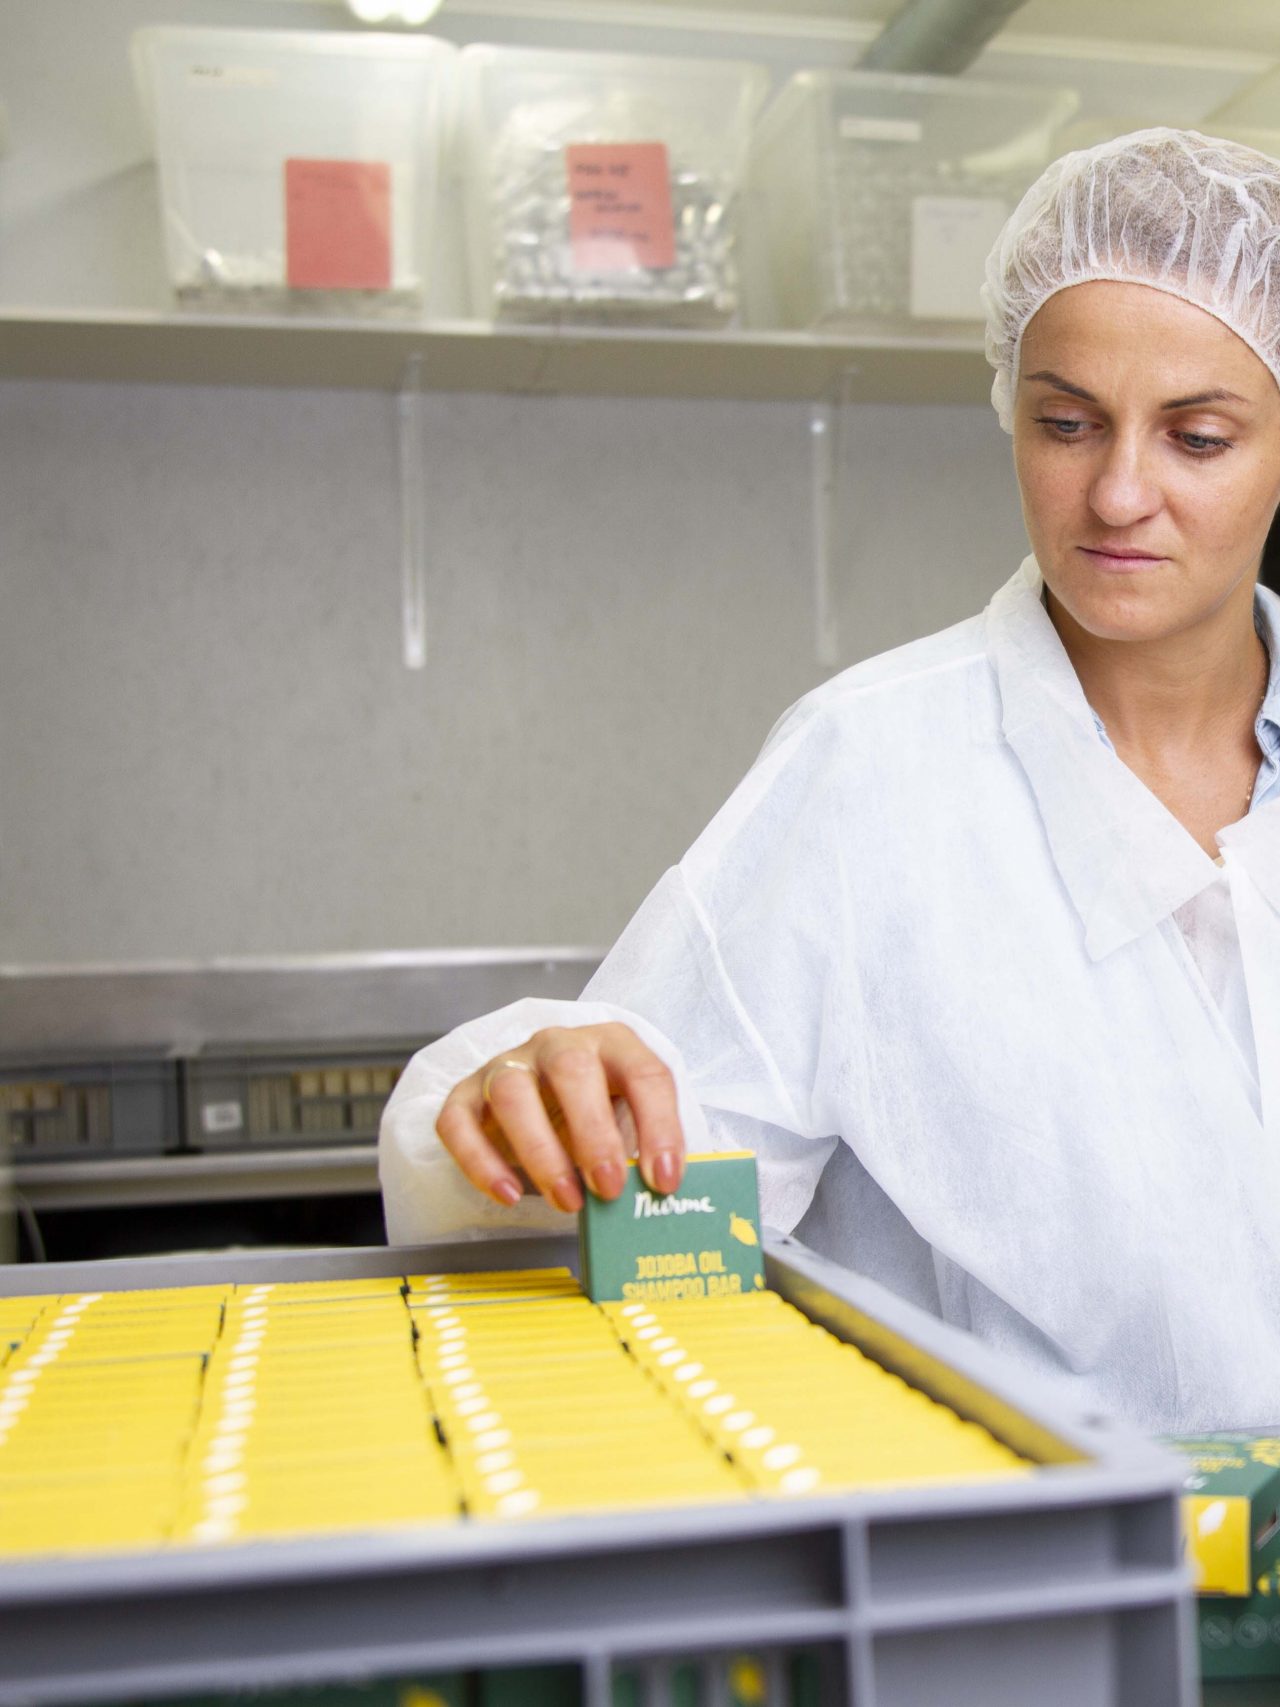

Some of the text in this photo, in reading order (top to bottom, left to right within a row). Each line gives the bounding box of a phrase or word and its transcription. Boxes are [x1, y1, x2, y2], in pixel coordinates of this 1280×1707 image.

[634, 1191, 716, 1219] Nurme
[636, 1250, 727, 1280] JOJOBA OIL
